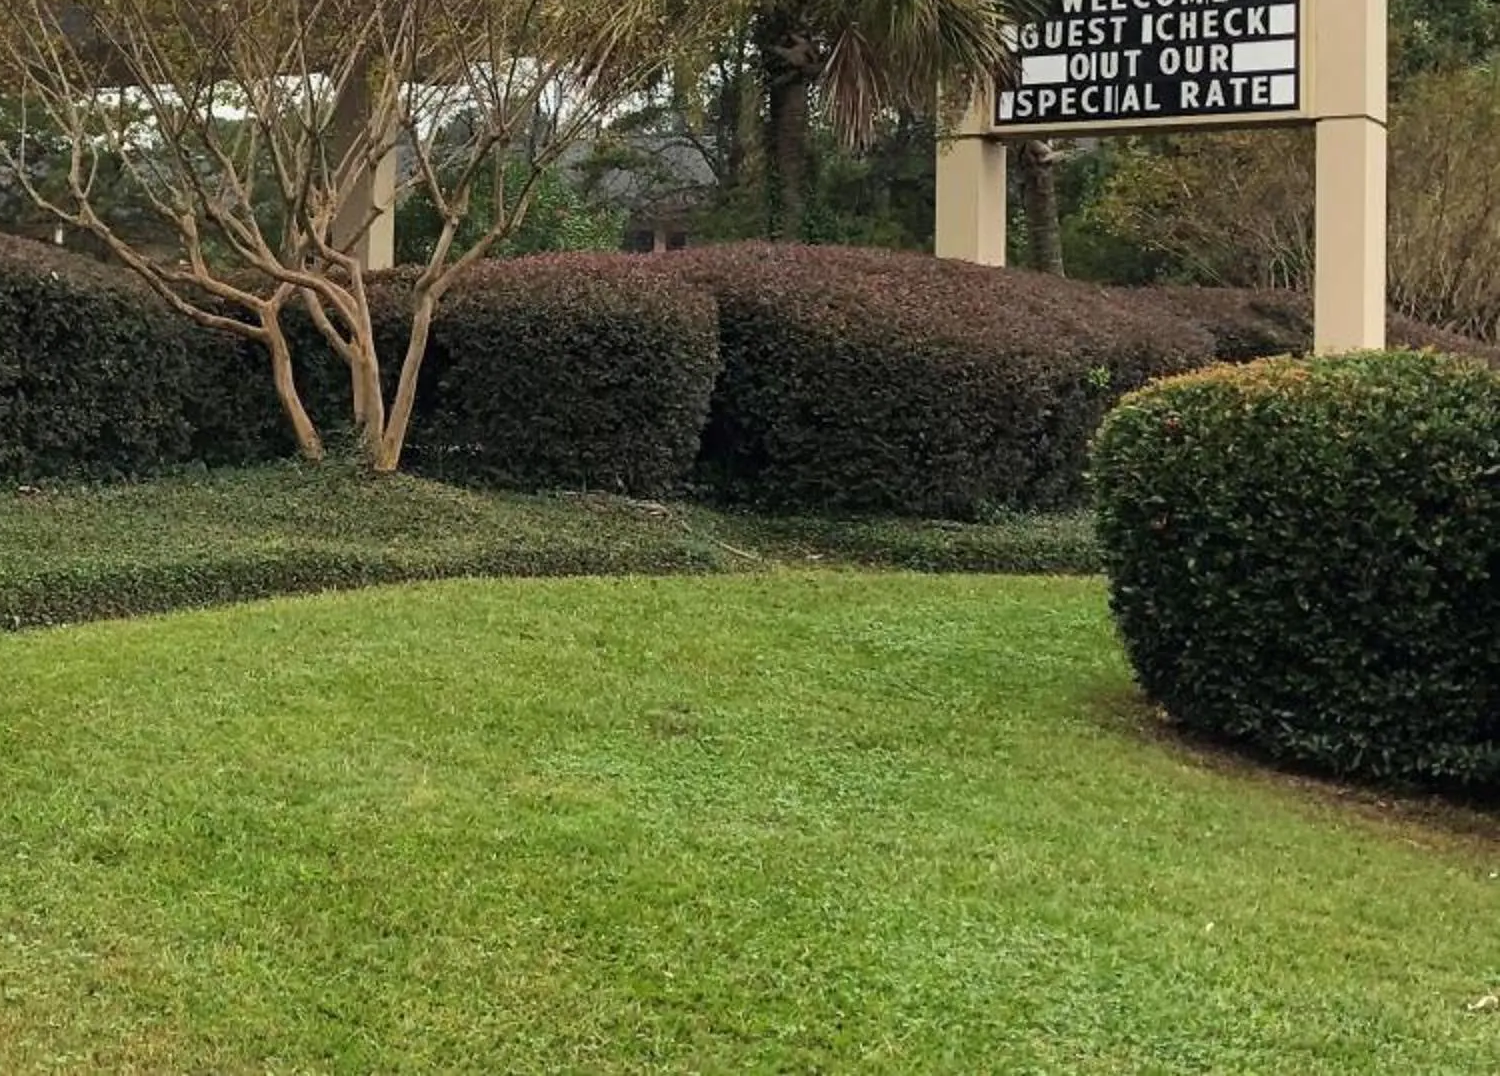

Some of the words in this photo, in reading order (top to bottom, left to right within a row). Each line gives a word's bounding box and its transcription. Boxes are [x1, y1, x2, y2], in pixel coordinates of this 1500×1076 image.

[1019, 16, 1127, 50] GUEST
[1156, 6, 1269, 41] CHECK
[1069, 50, 1142, 81] OUT
[1159, 44, 1229, 75] OUR
[1016, 83, 1160, 117] SPECIAL
[1180, 76, 1269, 109] RATE
